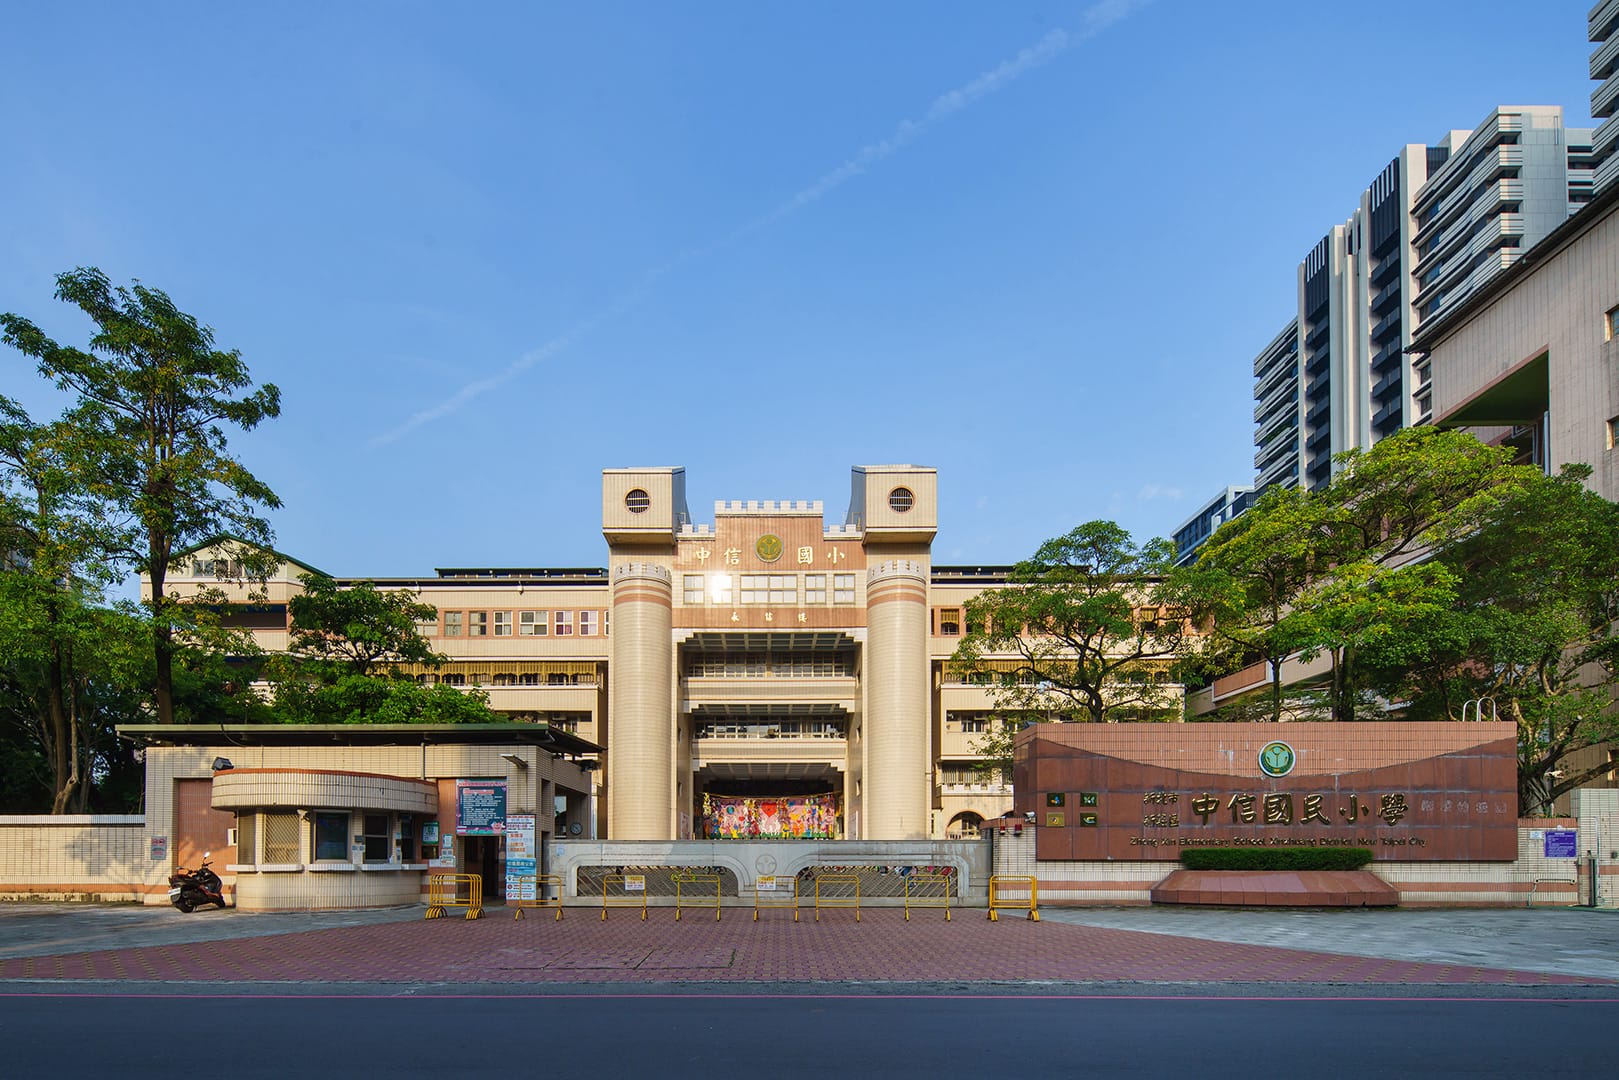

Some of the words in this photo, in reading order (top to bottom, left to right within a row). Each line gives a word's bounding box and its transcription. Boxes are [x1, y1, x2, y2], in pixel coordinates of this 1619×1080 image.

[695, 547, 845, 566] 中信國小
[1143, 791, 1180, 805] 新北市
[1191, 792, 1409, 827] 中信國民小學
[1129, 836, 1158, 848] Zhong
[1161, 837, 1176, 846] Xin
[1178, 837, 1231, 847] Elementary
[1408, 837, 1426, 848] City
